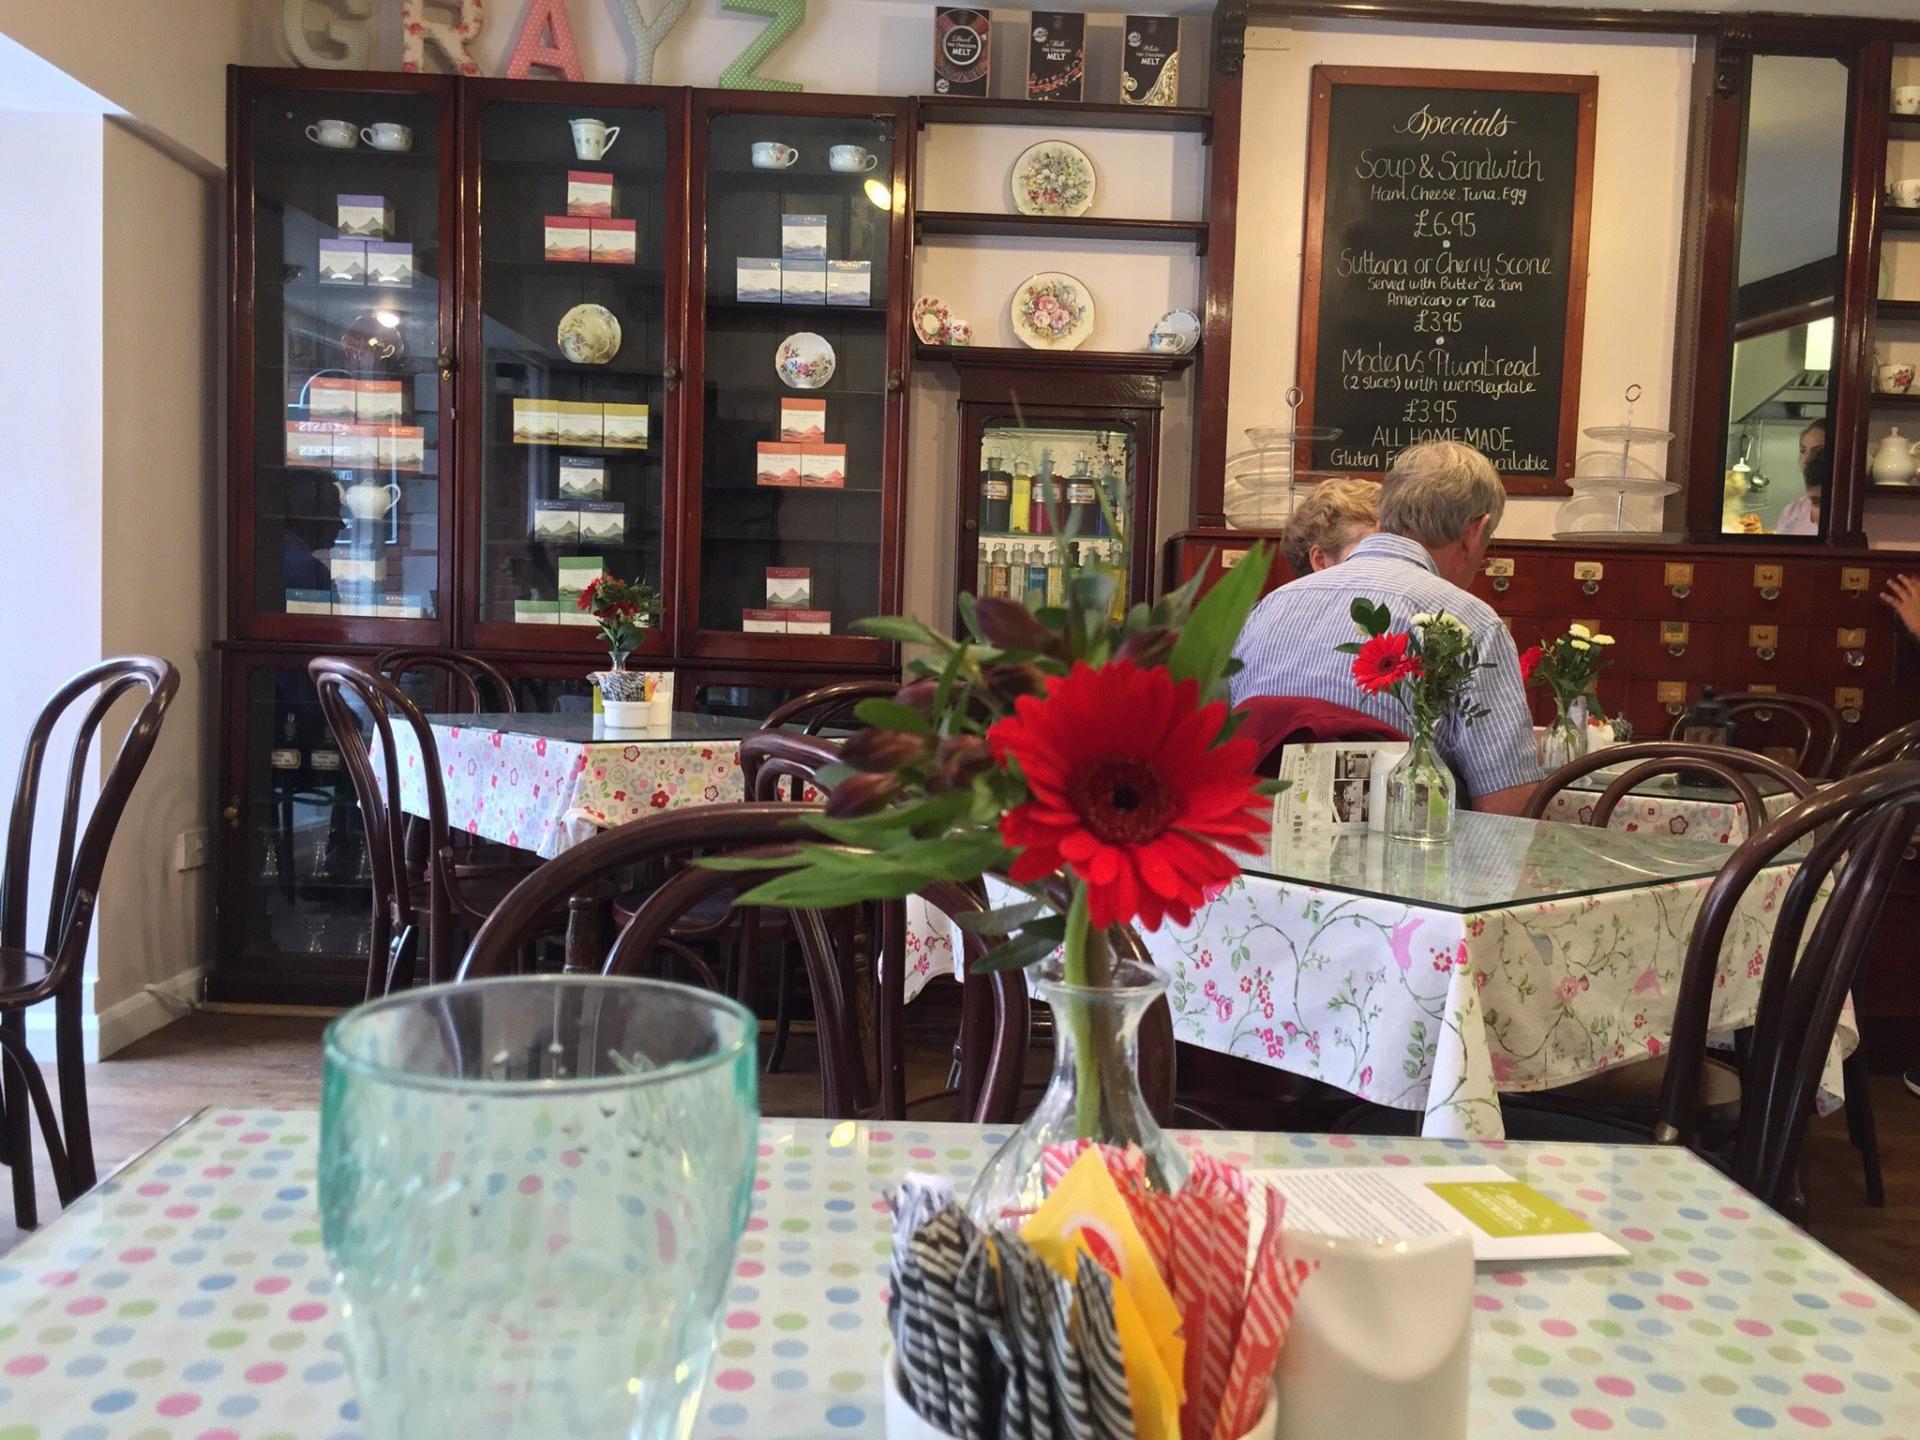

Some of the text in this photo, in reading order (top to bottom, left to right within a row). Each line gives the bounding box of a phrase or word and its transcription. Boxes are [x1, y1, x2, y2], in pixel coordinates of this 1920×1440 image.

[951, 47, 972, 56] MELT
[1046, 52, 1067, 61] MELT
[1140, 57, 1160, 66] MELT
[1393, 104, 1517, 141] Specials
[1355, 147, 1545, 192] Soup & Sandwich
[1502, 187, 1528, 205] Egg
[1413, 208, 1477, 238] £6.95
[1336, 248, 1552, 281] Sultana or Cherry Scone
[1368, 275, 1523, 292] Served with Butter & Jam
[1387, 291, 1496, 309] Americano or Tea
[1414, 309, 1463, 333] £3.95
[1428, 344, 1541, 378] Plumbread
[1343, 374, 1537, 401] (2 slices) with wensleydale
[1402, 398, 1458, 424] £3.95
[1371, 425, 1403, 448] ALL
[1330, 448, 1379, 468] Gluten
